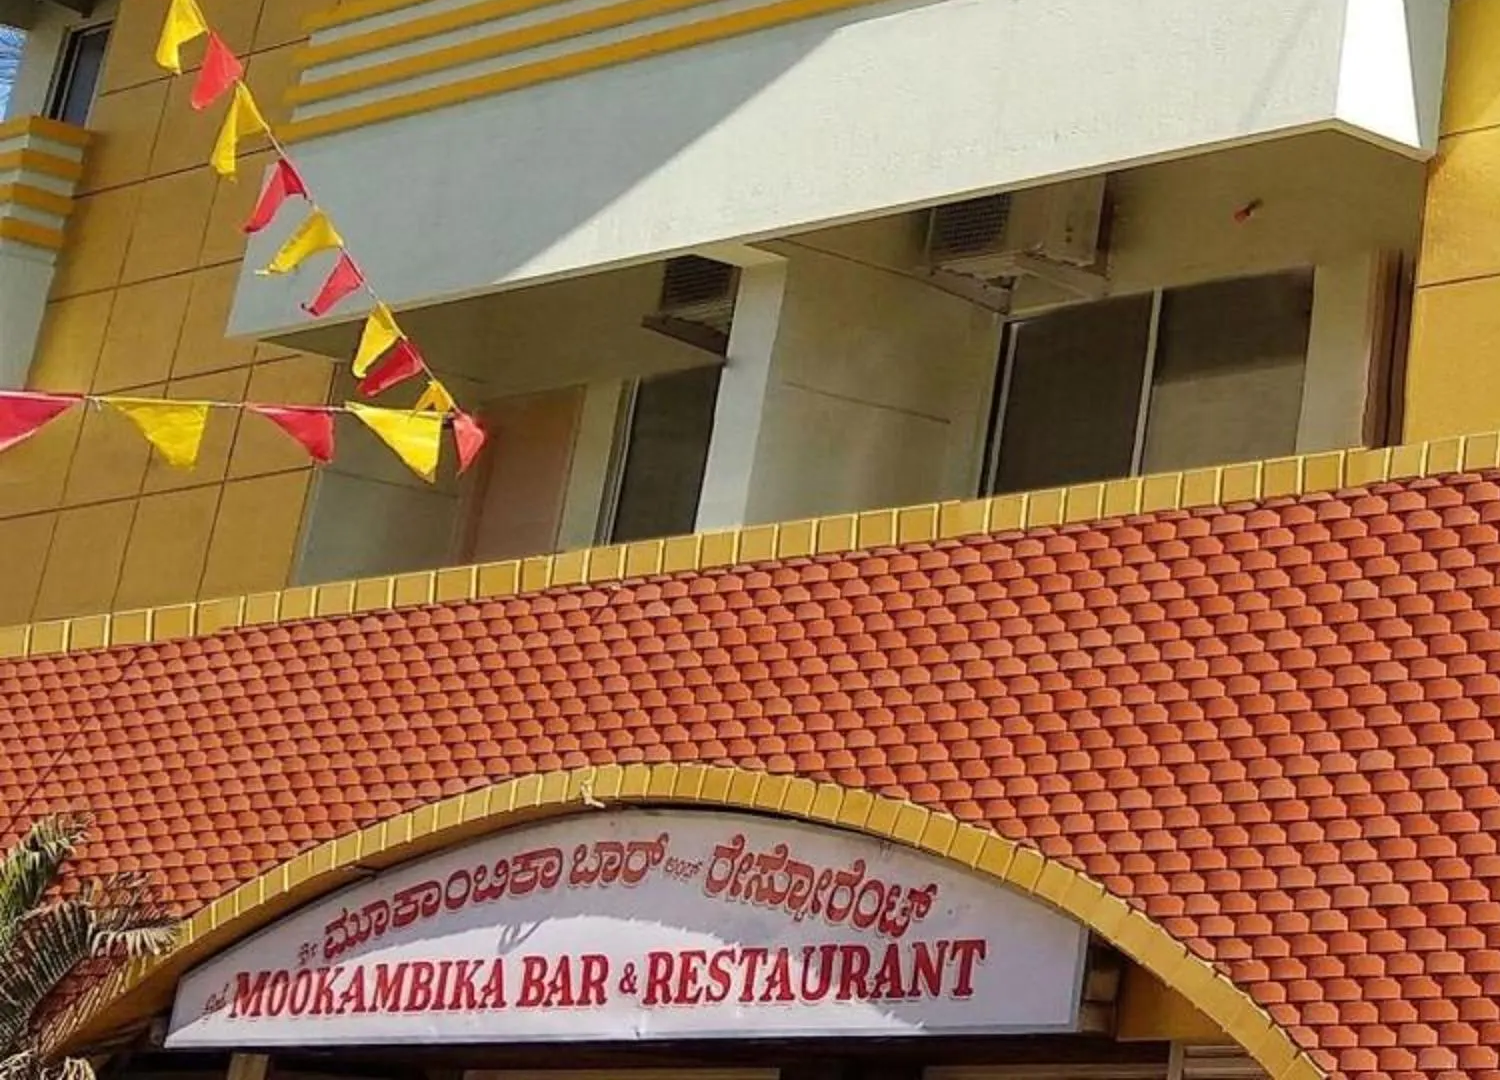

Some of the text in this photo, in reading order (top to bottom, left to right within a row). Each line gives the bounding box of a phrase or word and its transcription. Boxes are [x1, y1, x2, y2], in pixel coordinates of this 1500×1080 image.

[323, 847, 563, 959] ಮೂಕಾಂಬಿಕಾ
[569, 832, 669, 886] ಬಾರ್
[229, 958, 506, 1018] MOOKAMBIKA
[516, 954, 608, 1007] BAR
[619, 963, 638, 995] &
[643, 939, 986, 1005] RESTAURANT
